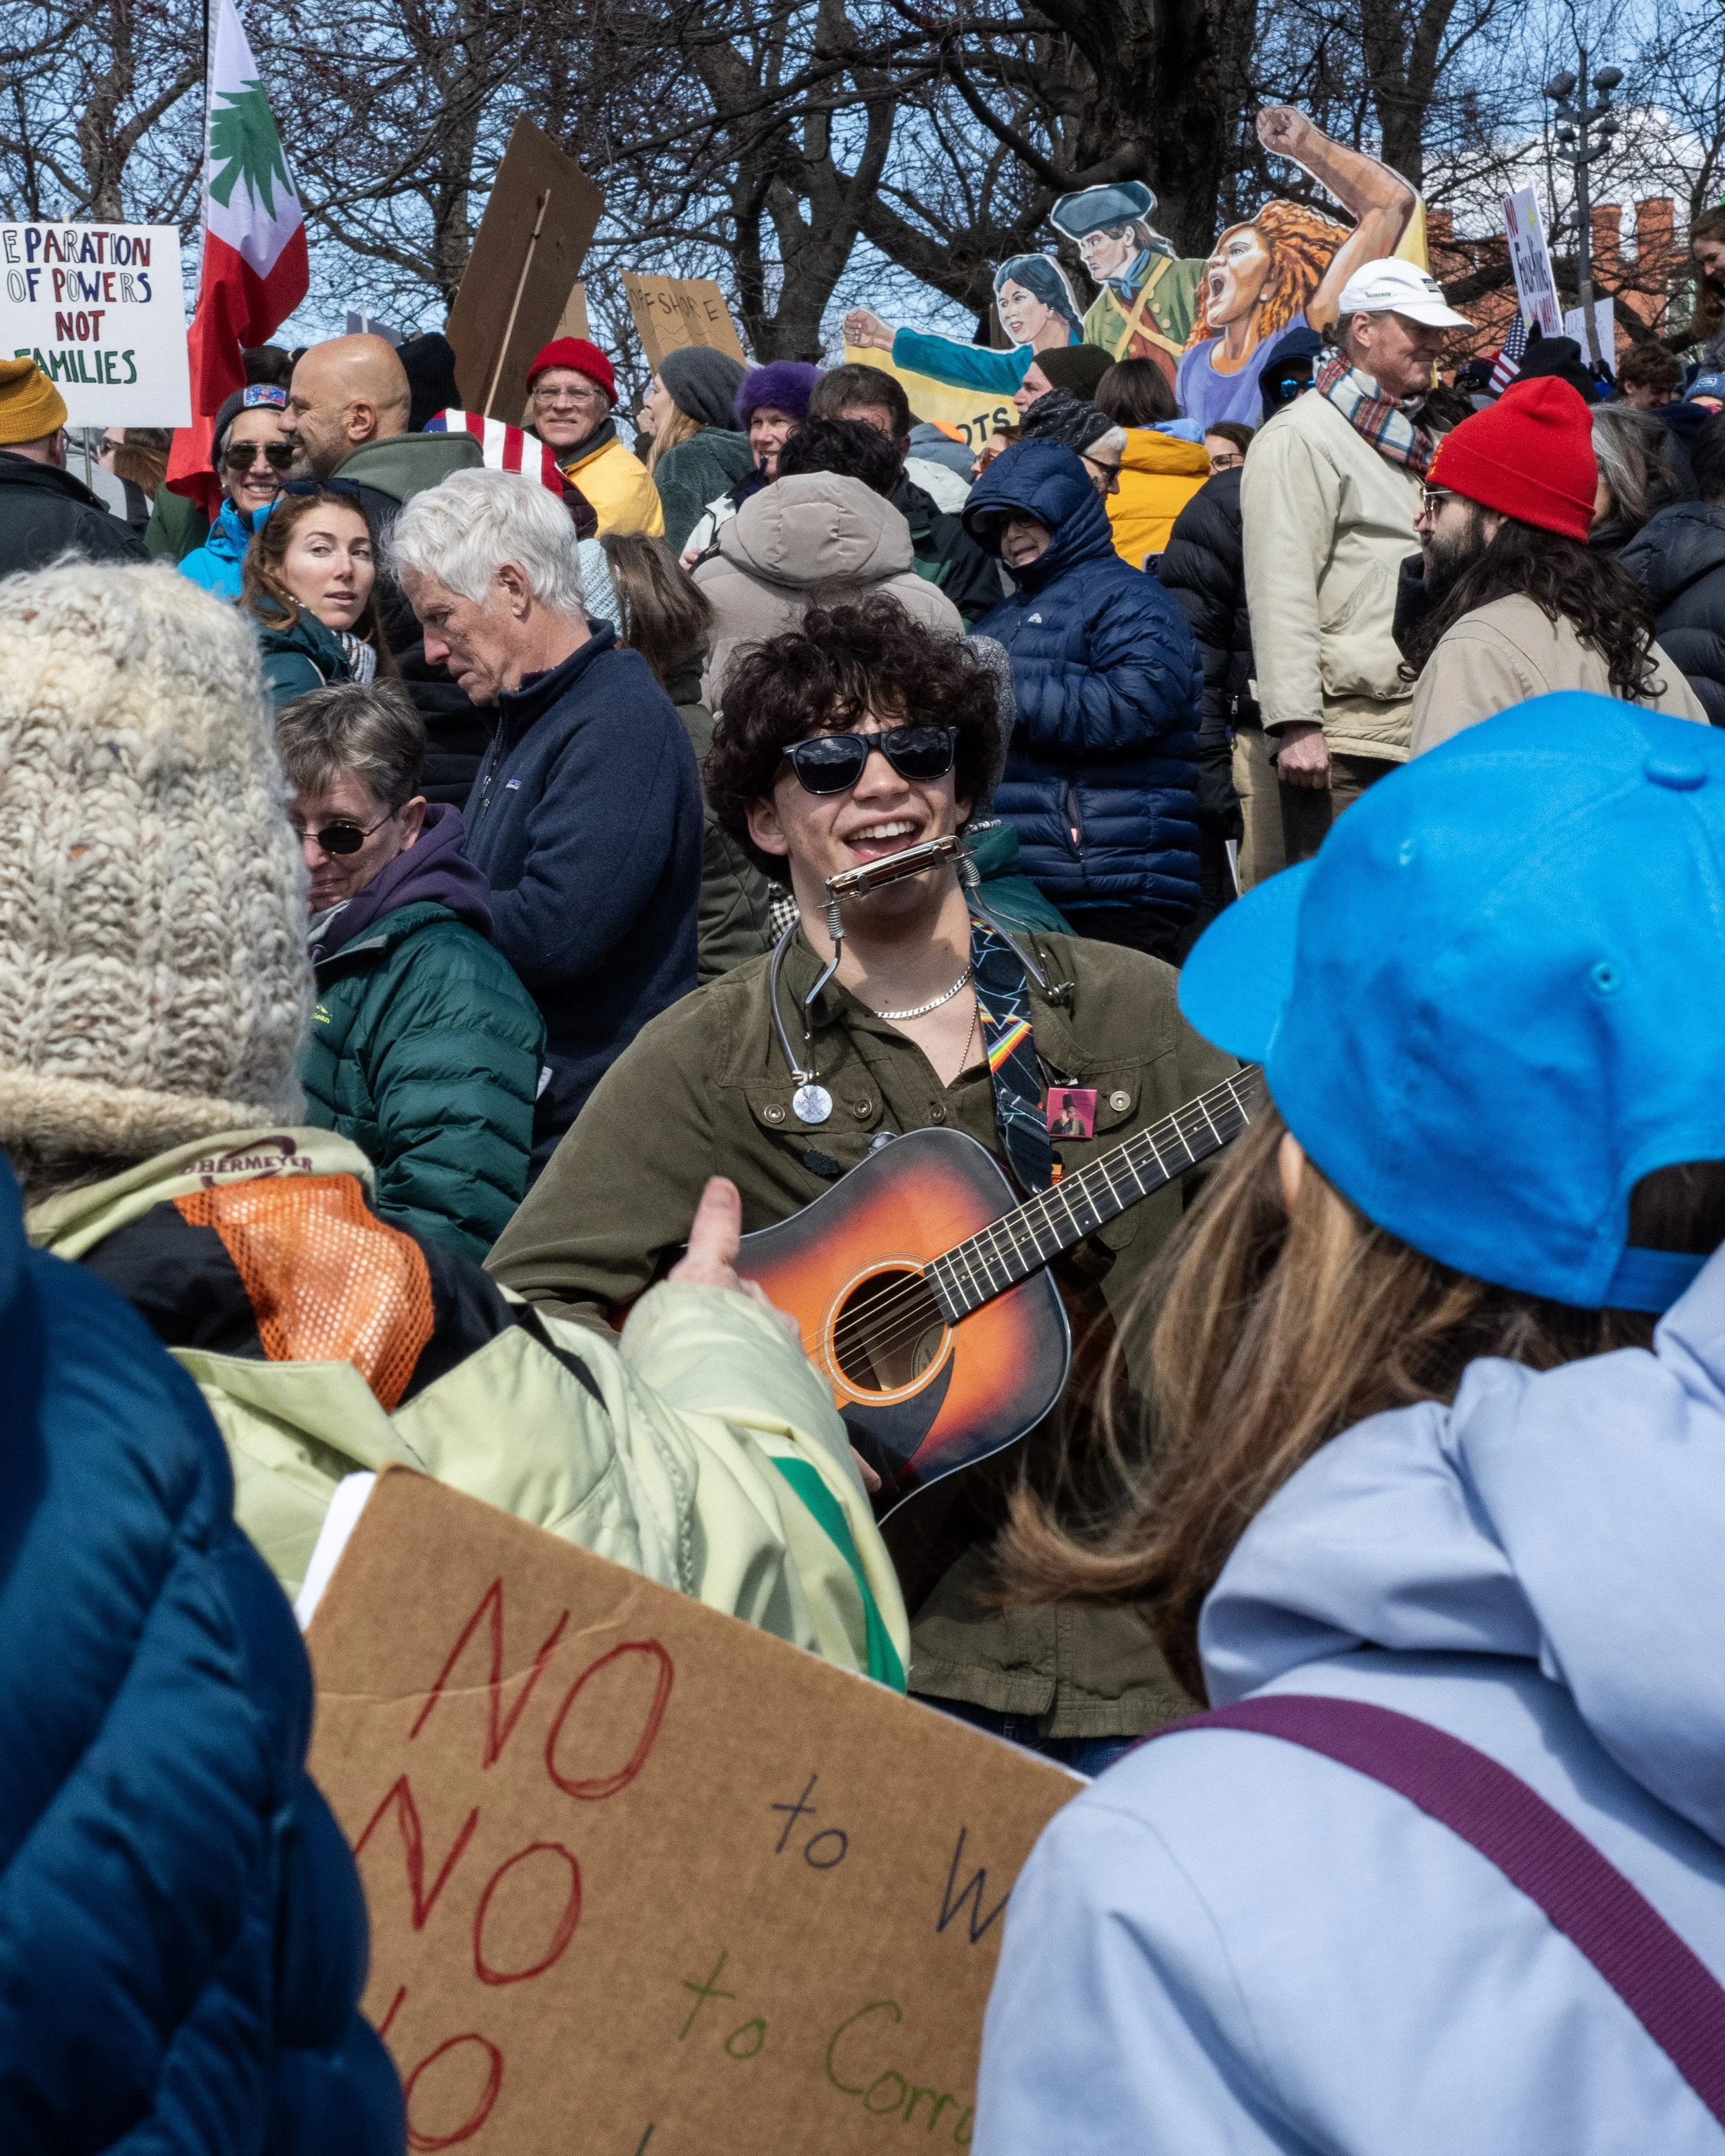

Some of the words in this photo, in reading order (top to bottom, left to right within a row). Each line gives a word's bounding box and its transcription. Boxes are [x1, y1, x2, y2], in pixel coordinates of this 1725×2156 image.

[1504, 197, 1519, 239] NO
[7, 268, 41, 303] OF
[52, 268, 152, 304] POWERS
[55, 310, 105, 342] NOT
[408, 1578, 673, 1801] NO
[770, 1772, 848, 1869] to
[355, 1773, 583, 1987] NO
[676, 1950, 766, 2060] to
